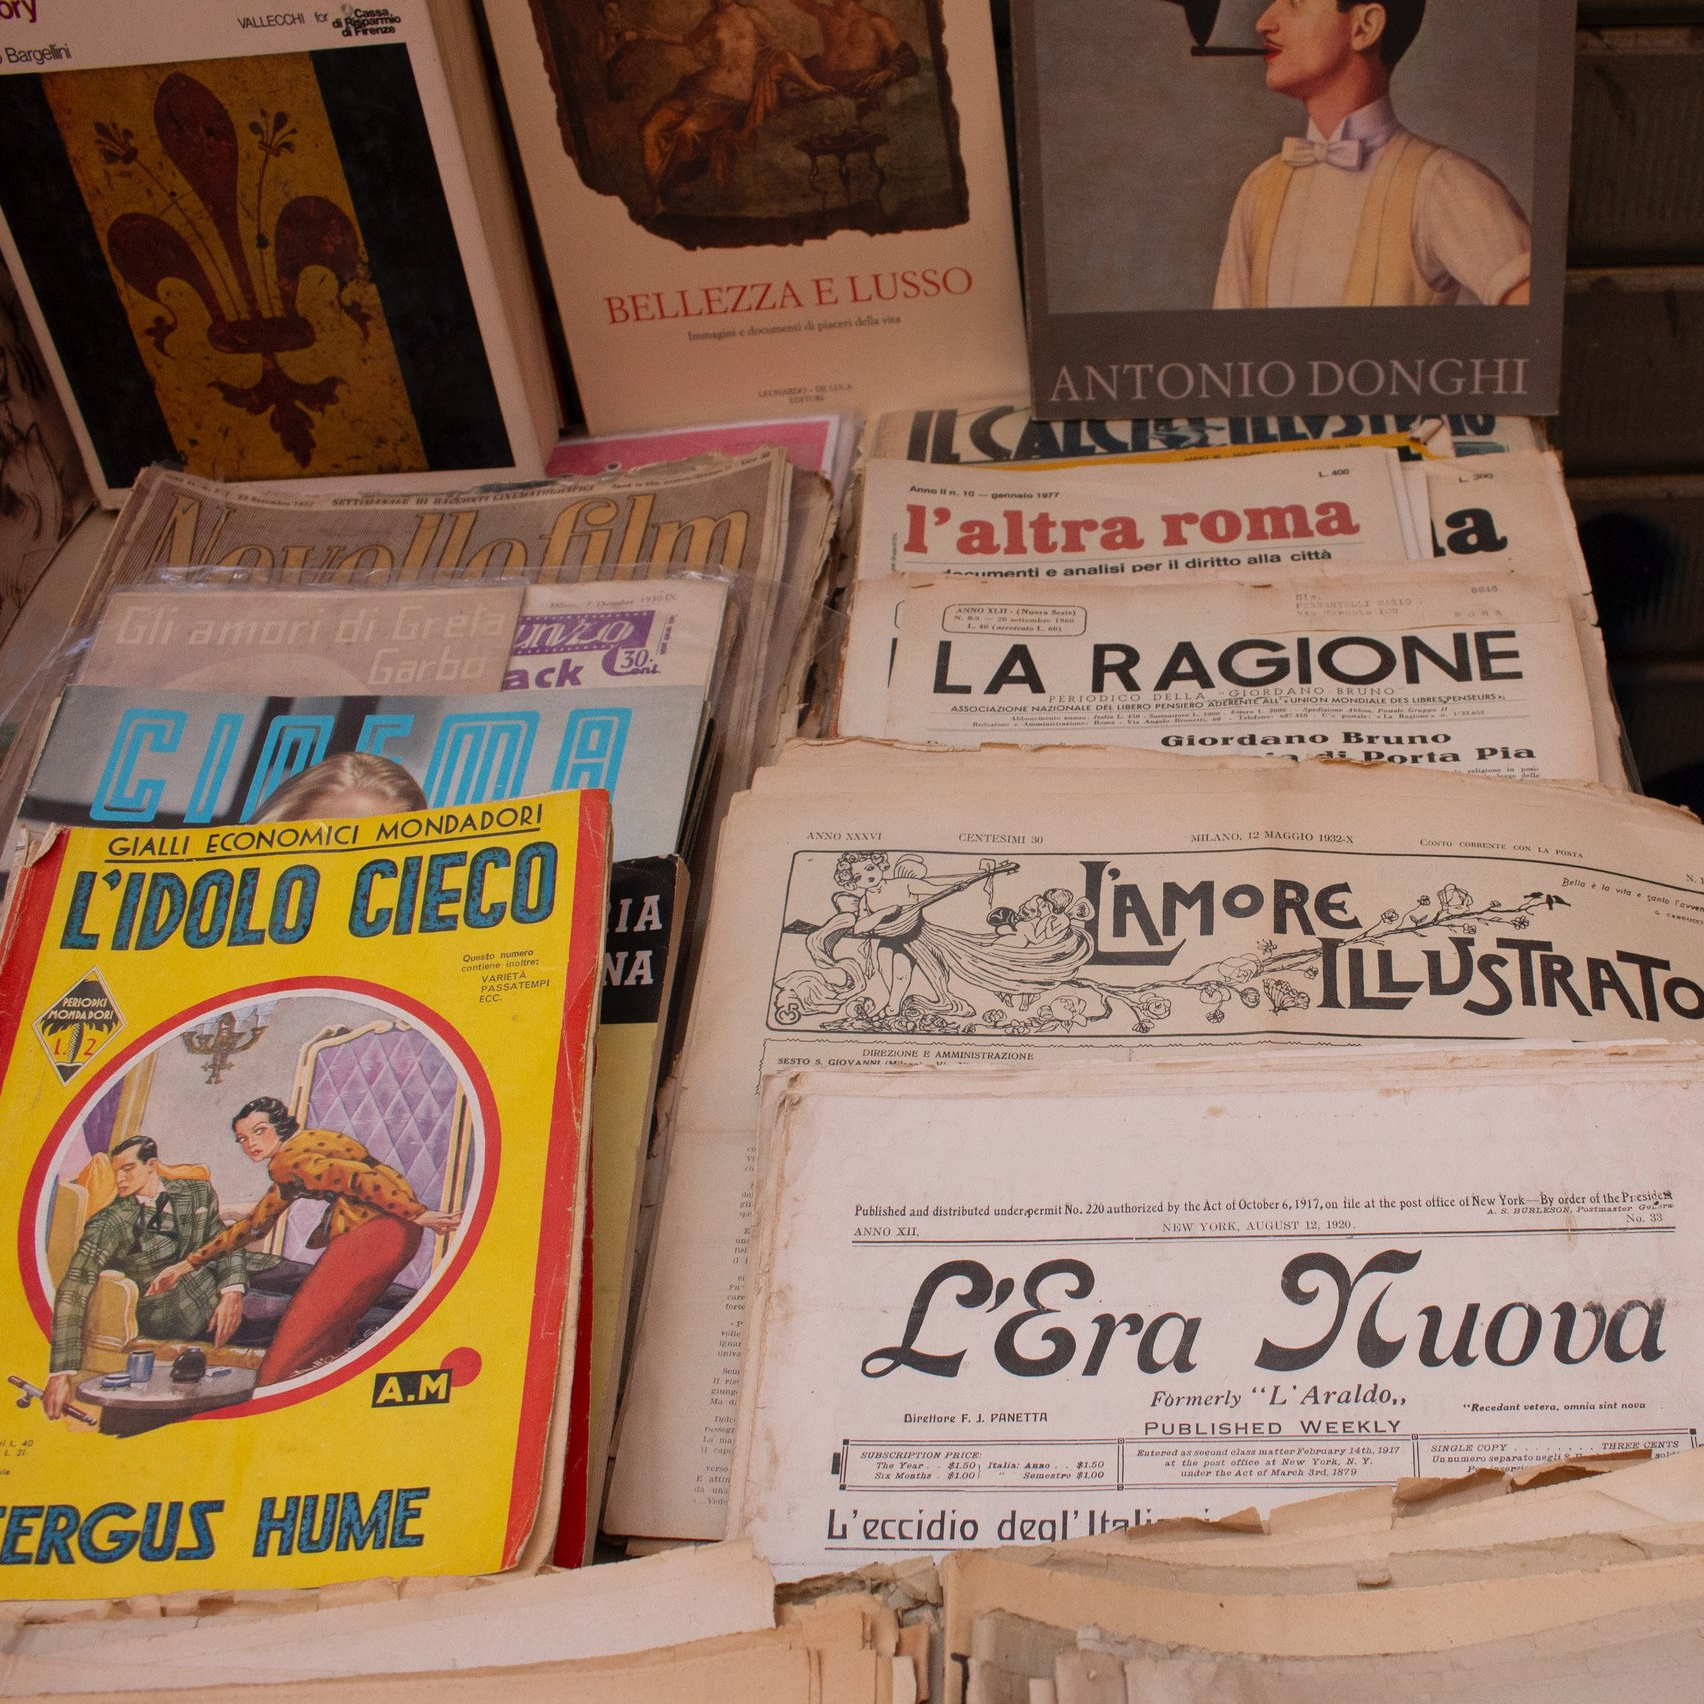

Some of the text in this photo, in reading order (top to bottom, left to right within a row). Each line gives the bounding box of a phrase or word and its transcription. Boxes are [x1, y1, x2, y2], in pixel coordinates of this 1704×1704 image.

[237, 11, 329, 29] VALLECCHI for
[354, 8, 389, 18] Cassa
[332, 15, 402, 29] di Risparmio
[342, 25, 396, 37] di Firenze
[5, 43, 72, 65] Bargellini
[604, 267, 973, 325] BELLEZZA E LUSSO
[1049, 358, 1530, 402] ANTONIO DONGHI
[1318, 468, 1350, 478] L. 400
[909, 485, 938, 495] Anno
[949, 489, 959, 497] n.
[963, 489, 975, 497] 10
[991, 492, 1033, 500] gennaio
[1036, 491, 1060, 499] 1977
[903, 504, 1145, 555] l'altra
[1161, 501, 1360, 546] roma
[1045, 549, 1332, 577] e analisi per il diritto alla città
[115, 604, 507, 646] Gli amori di Greta
[368, 645, 487, 686] Garbo
[933, 630, 1523, 695] LA RAGIONE
[1048, 694, 1141, 703] PERIODICO
[1153, 692, 1206, 701] DELLA
[951, 705, 1028, 713] ASSOCIAZIONE
[1031, 704, 1092, 712] NAZIONALE
[1155, 702, 1204, 710] PENSIERO
[1160, 731, 1452, 747] Giordano Bruno
[1363, 746, 1537, 764] Porta Pia
[108, 803, 544, 858] GIALLI ECONOMICI MONDADORI
[806, 831, 1355, 845] ANNO XXXVI CENTESIMI 30 MILANO, 12 MAGGIO 1932-X
[59, 840, 558, 952] L'IDOLO CIECO
[1079, 860, 1363, 967] L'AMORE
[462, 950, 534, 963] Questo numero
[461, 958, 539, 972] contiene inoltre:
[481, 970, 527, 983] VARIETÀ
[1316, 936, 1704, 1022] ILLUSTRATO
[481, 979, 550, 993] PASSATEMPI
[62, 998, 108, 1007] PERIODICI
[479, 994, 503, 1003] ECC.
[48, 1009, 114, 1020] MONDADORI
[862, 1049, 1034, 1060] DIREZIONE E AMMINISTRAZIONE
[854, 1204, 906, 1217] Published
[909, 1205, 929, 1217] and
[932, 1204, 990, 1217] distributed
[1064, 1203, 1083, 1215] No.
[1085, 1203, 1105, 1215] 220
[1106, 1201, 1164, 1215] authorized
[1167, 1201, 1180, 1215] by
[1184, 1200, 1201, 1213] the
[1203, 1200, 1222, 1212] Act
[1225, 1200, 1237, 1212] of
[1238, 1199, 1281, 1211] October
[1281, 1199, 1292, 1212] 6,
[1295, 1198, 1324, 1211] 1917,
[1325, 1201, 1338, 1210] on
[1342, 1197, 1361, 1210] file
[1364, 1198, 1376, 1209] at
[1379, 1196, 1396, 1209] the
[1400, 1197, 1422, 1211] post
[1425, 1193, 1457, 1207] office
[1459, 1193, 1471, 1207] of
[1472, 1193, 1496, 1207] New
[1558, 1191, 1584, 1205] order
[1589, 1190, 1601, 1205] of
[1602, 1190, 1620, 1204] the
[854, 1226, 891, 1236] ANNO
[897, 1226, 920, 1237] XII.
[1162, 1223, 1194, 1233] NEW
[1200, 1222, 1240, 1233] YORK,
[1246, 1220, 1299, 1232] AUGUST
[1327, 1219, 1356, 1230] 1920.
[1626, 1213, 1646, 1224] No.
[1650, 1213, 1663, 1223] 33
[860, 1249, 1668, 1379] L'Era Nuova
[376, 1373, 449, 1403] A.M
[1150, 1390, 1242, 1409] Formerly
[1523, 1402, 1560, 1412] vetera,
[1563, 1402, 1596, 1411] omnia
[1598, 1401, 1618, 1411] sint
[1621, 1402, 1646, 1410] nova
[904, 1412, 1048, 1424] Direttore F. J. PANETTA
[1144, 1420, 1401, 1436] PUBLISHED WEEKLY
[1431, 1440, 1680, 1452] SINGLE COPY THREE CENTS
[860, 1451, 982, 1460] SUBSCRIPTION PRICE:
[1164, 1457, 1341, 1468] at the post office at New York,
[0, 1486, 430, 1565] ERGUS HUME
[826, 1507, 979, 1541] L'eccidio
